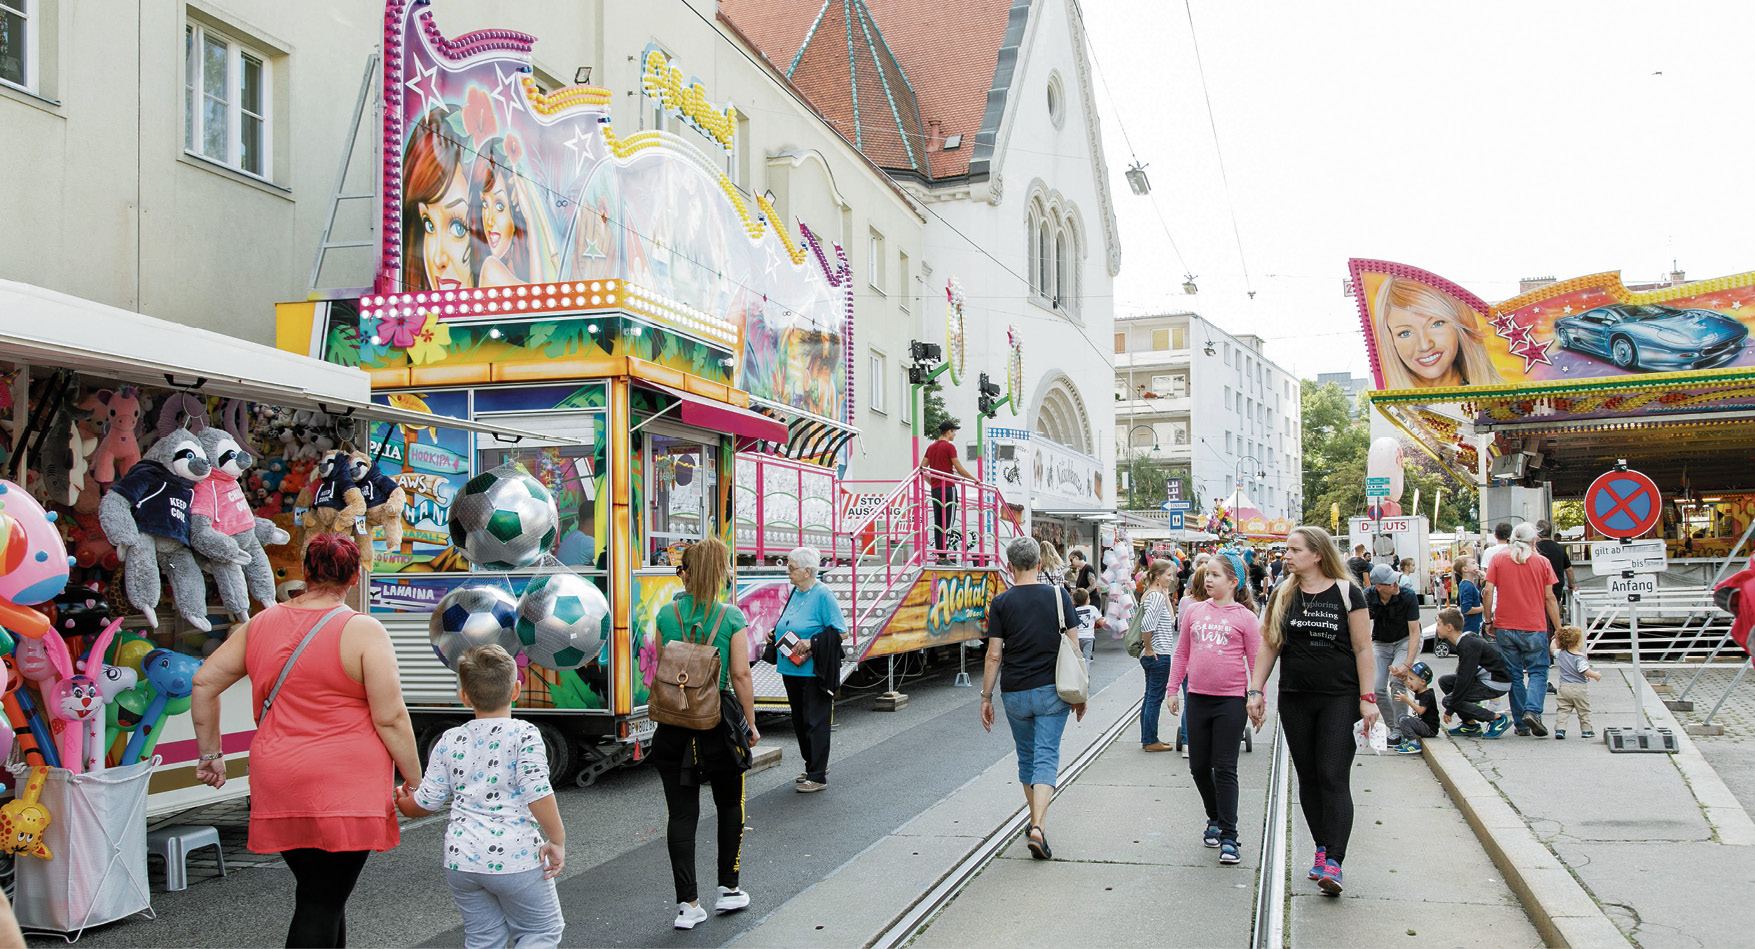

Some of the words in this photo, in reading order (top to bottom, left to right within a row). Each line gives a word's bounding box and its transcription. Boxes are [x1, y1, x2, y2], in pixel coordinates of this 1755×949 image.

[411, 448, 450, 467] HOOKIPA
[392, 475, 427, 493] AWS
[169, 497, 187, 510] KEEP
[1361, 521, 1406, 531] DUTS
[1595, 547, 1609, 557] gilt
[374, 554, 413, 564] OUNTRY
[1632, 560, 1644, 568] bis
[383, 585, 434, 600] LAHAINA
[1612, 580, 1653, 593] Anfang
[930, 574, 987, 629] Aloha!
[1302, 601, 1338, 610] exploring
[1304, 610, 1338, 620] trekking
[1290, 618, 1338, 631] #gotouring
[1194, 623, 1231, 646] Stars
[1309, 630, 1336, 640] tasting
